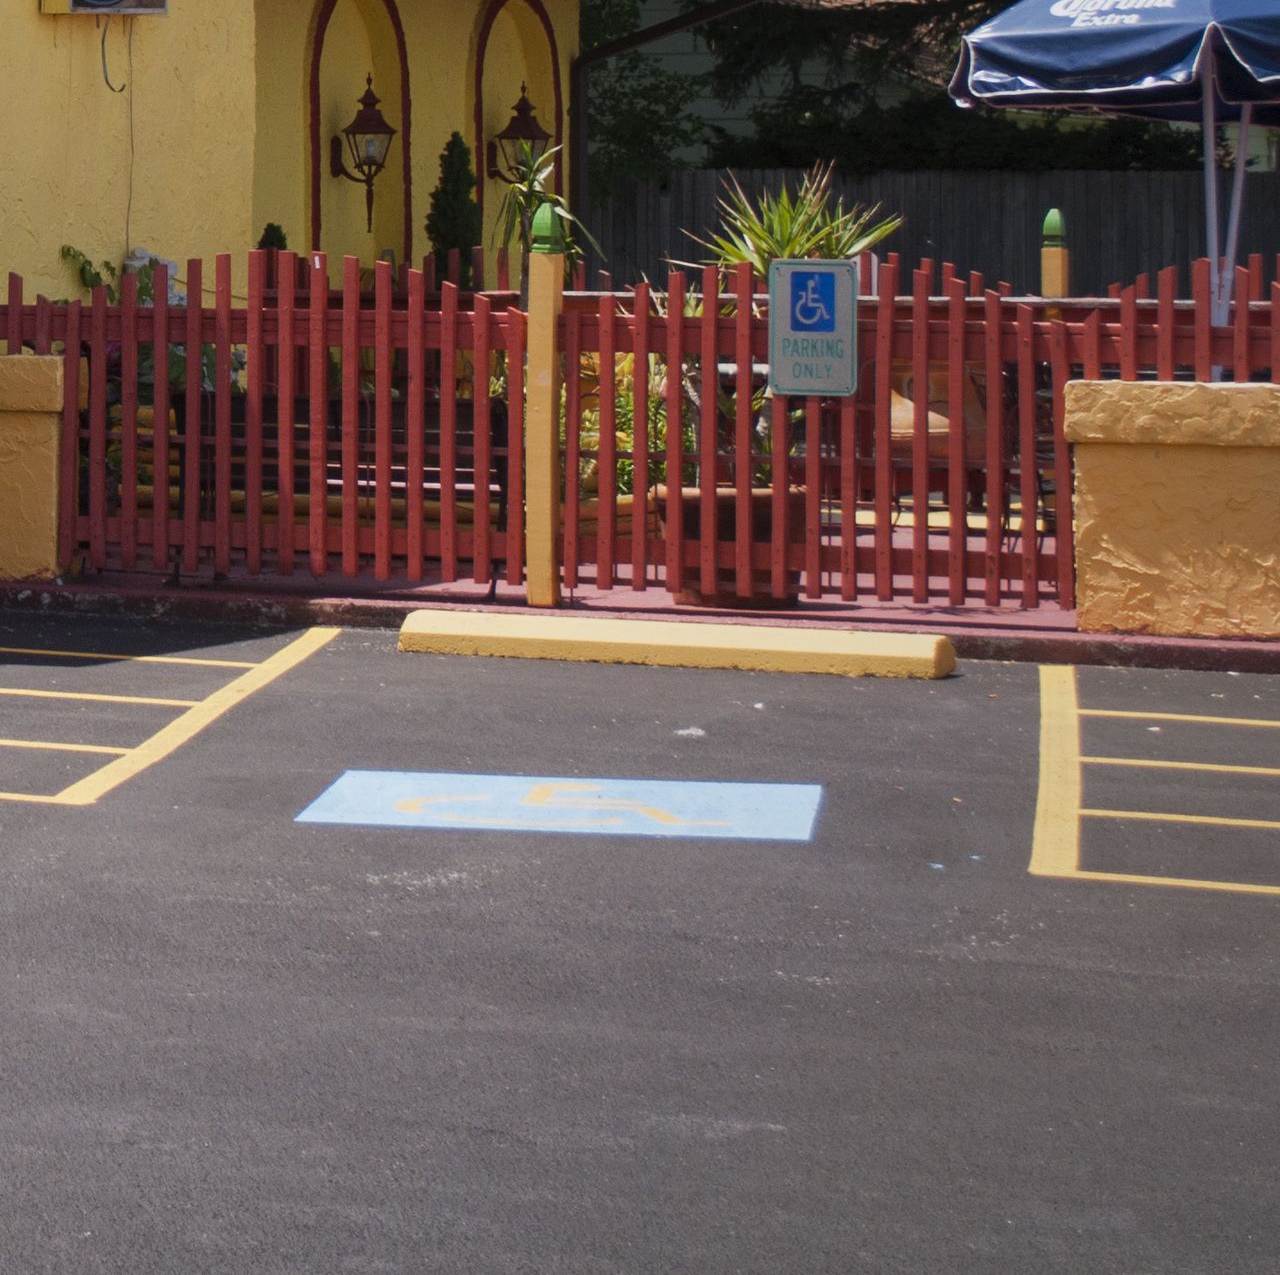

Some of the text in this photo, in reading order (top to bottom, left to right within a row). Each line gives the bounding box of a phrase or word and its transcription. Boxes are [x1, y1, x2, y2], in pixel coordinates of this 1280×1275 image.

[1070, 11, 1140, 27] Extra
[782, 338, 844, 358] PARKING
[792, 362, 833, 379] ONLY
